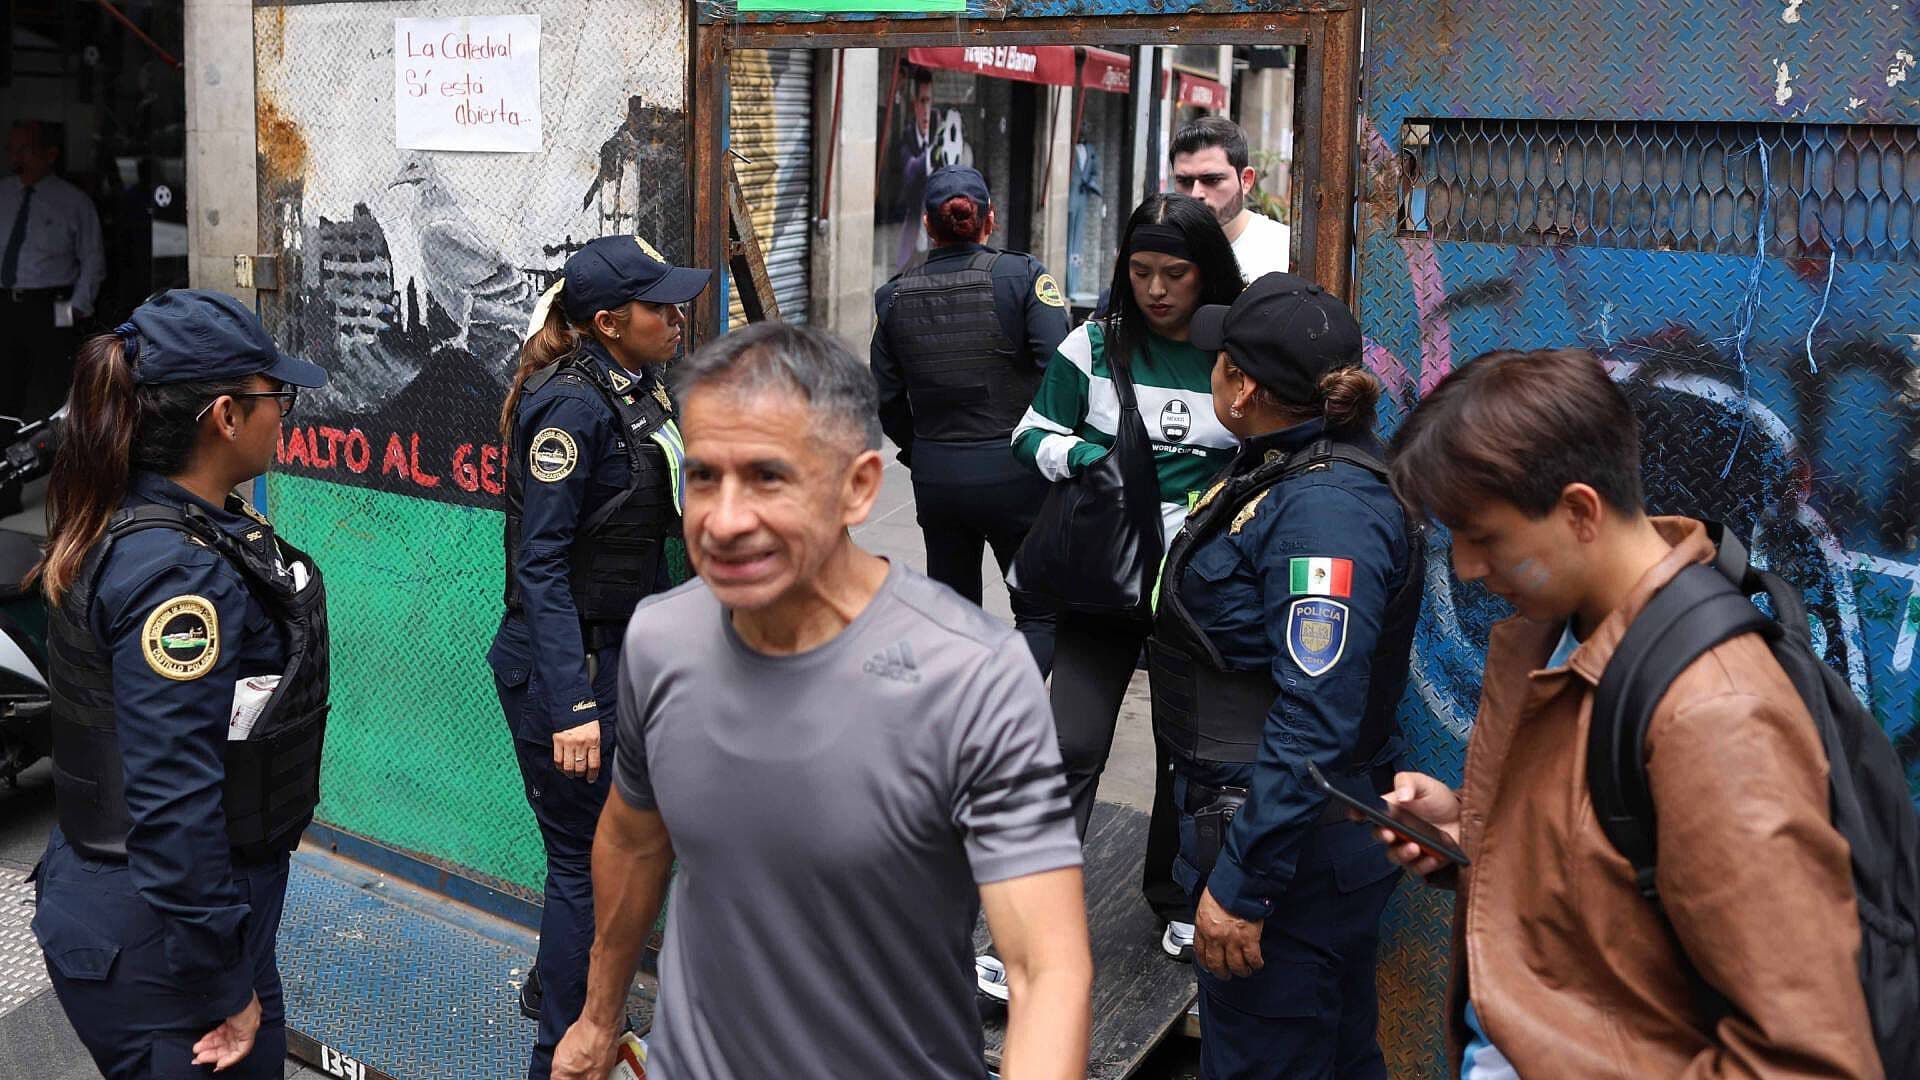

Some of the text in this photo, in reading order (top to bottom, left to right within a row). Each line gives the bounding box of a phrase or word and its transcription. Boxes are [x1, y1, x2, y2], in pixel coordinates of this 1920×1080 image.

[407, 31, 512, 60] La Catedral
[405, 68, 484, 97] Sí está
[1152, 443, 1178, 453] WORLD
[1177, 447, 1192, 455] CUP
[382, 431, 441, 488] AL
[453, 442, 508, 497] GE
[1296, 606, 1341, 621] POLICÍA
[152, 647, 184, 673] CASTILLO
[862, 658, 921, 684] adidas
[1302, 656, 1326, 666] CDMX
